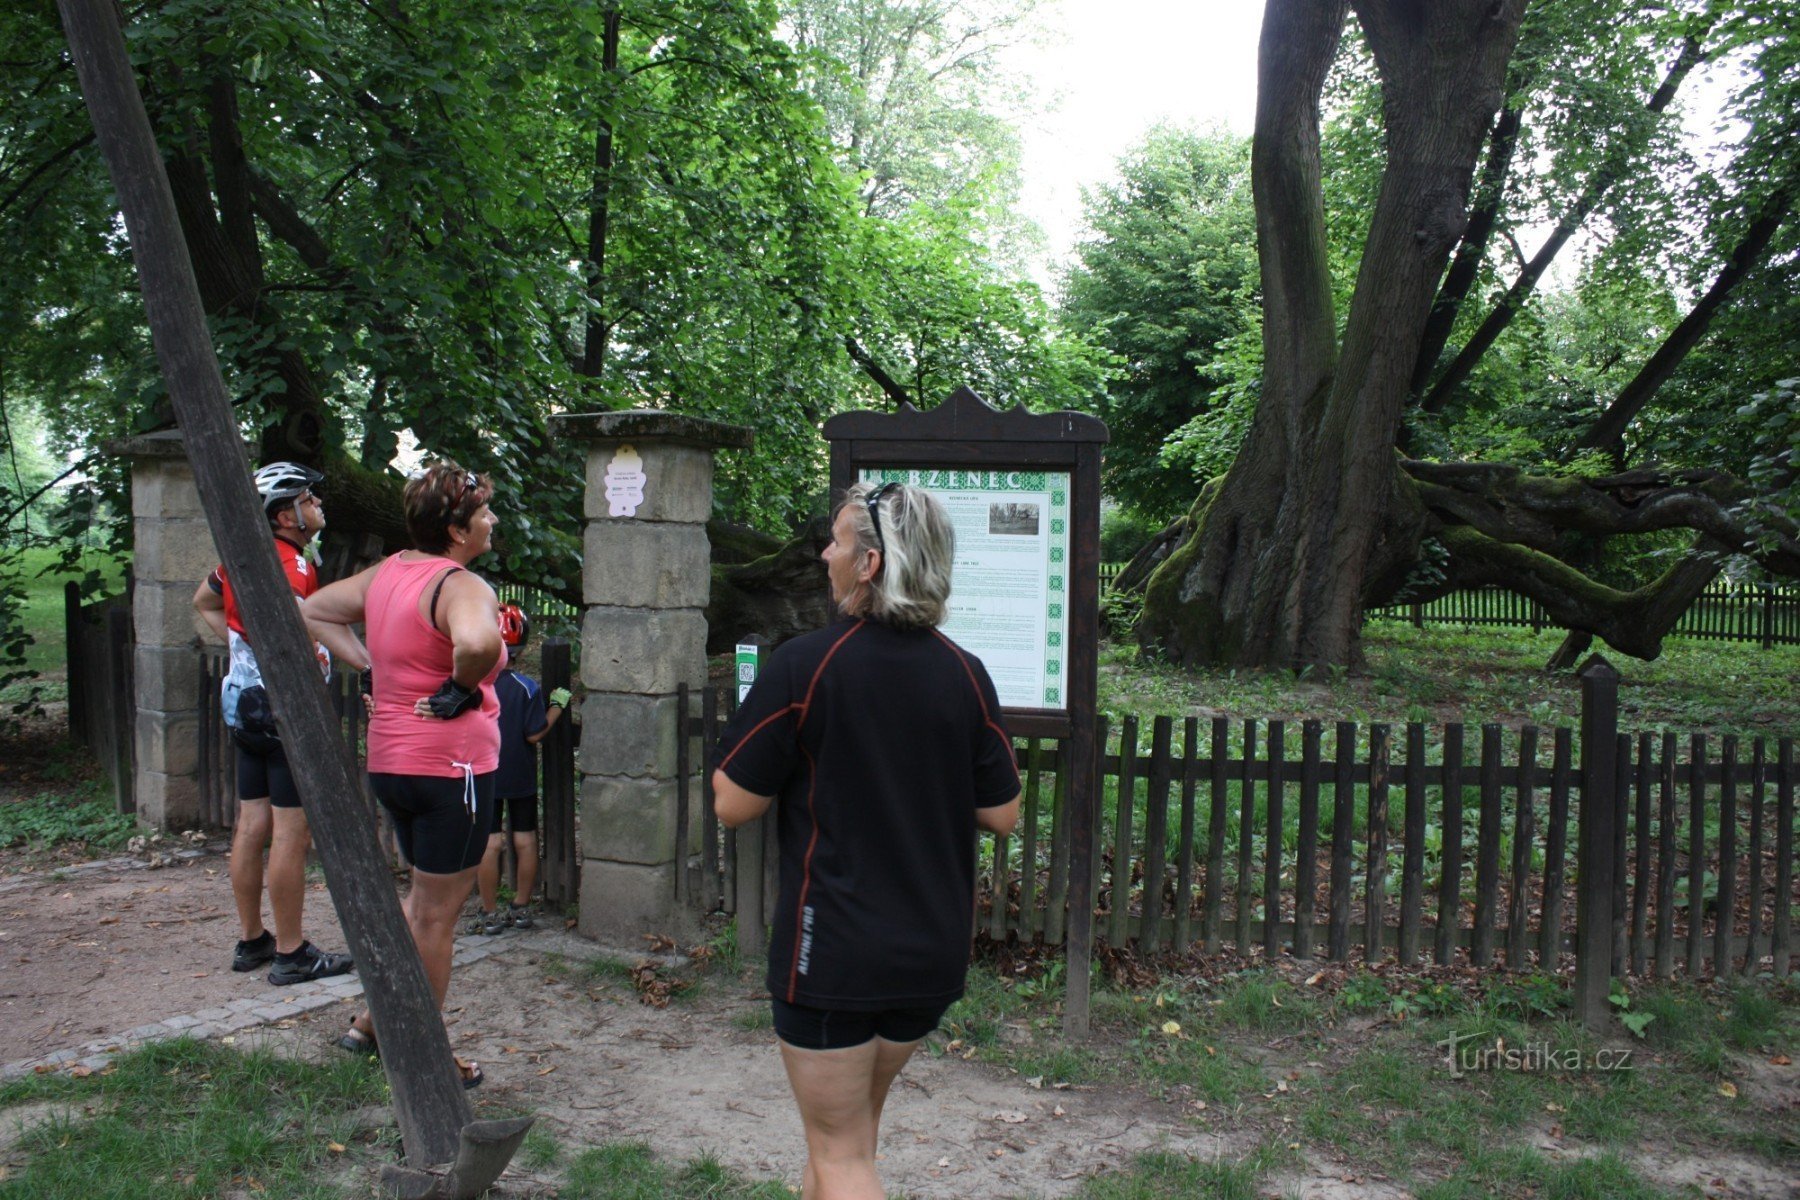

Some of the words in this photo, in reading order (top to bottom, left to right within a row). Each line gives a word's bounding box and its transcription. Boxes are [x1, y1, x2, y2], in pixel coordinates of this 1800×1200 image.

[908, 470, 1021, 488] BZENEC
[803, 906, 814, 931] PRO
[798, 932, 812, 975] ALPINE
